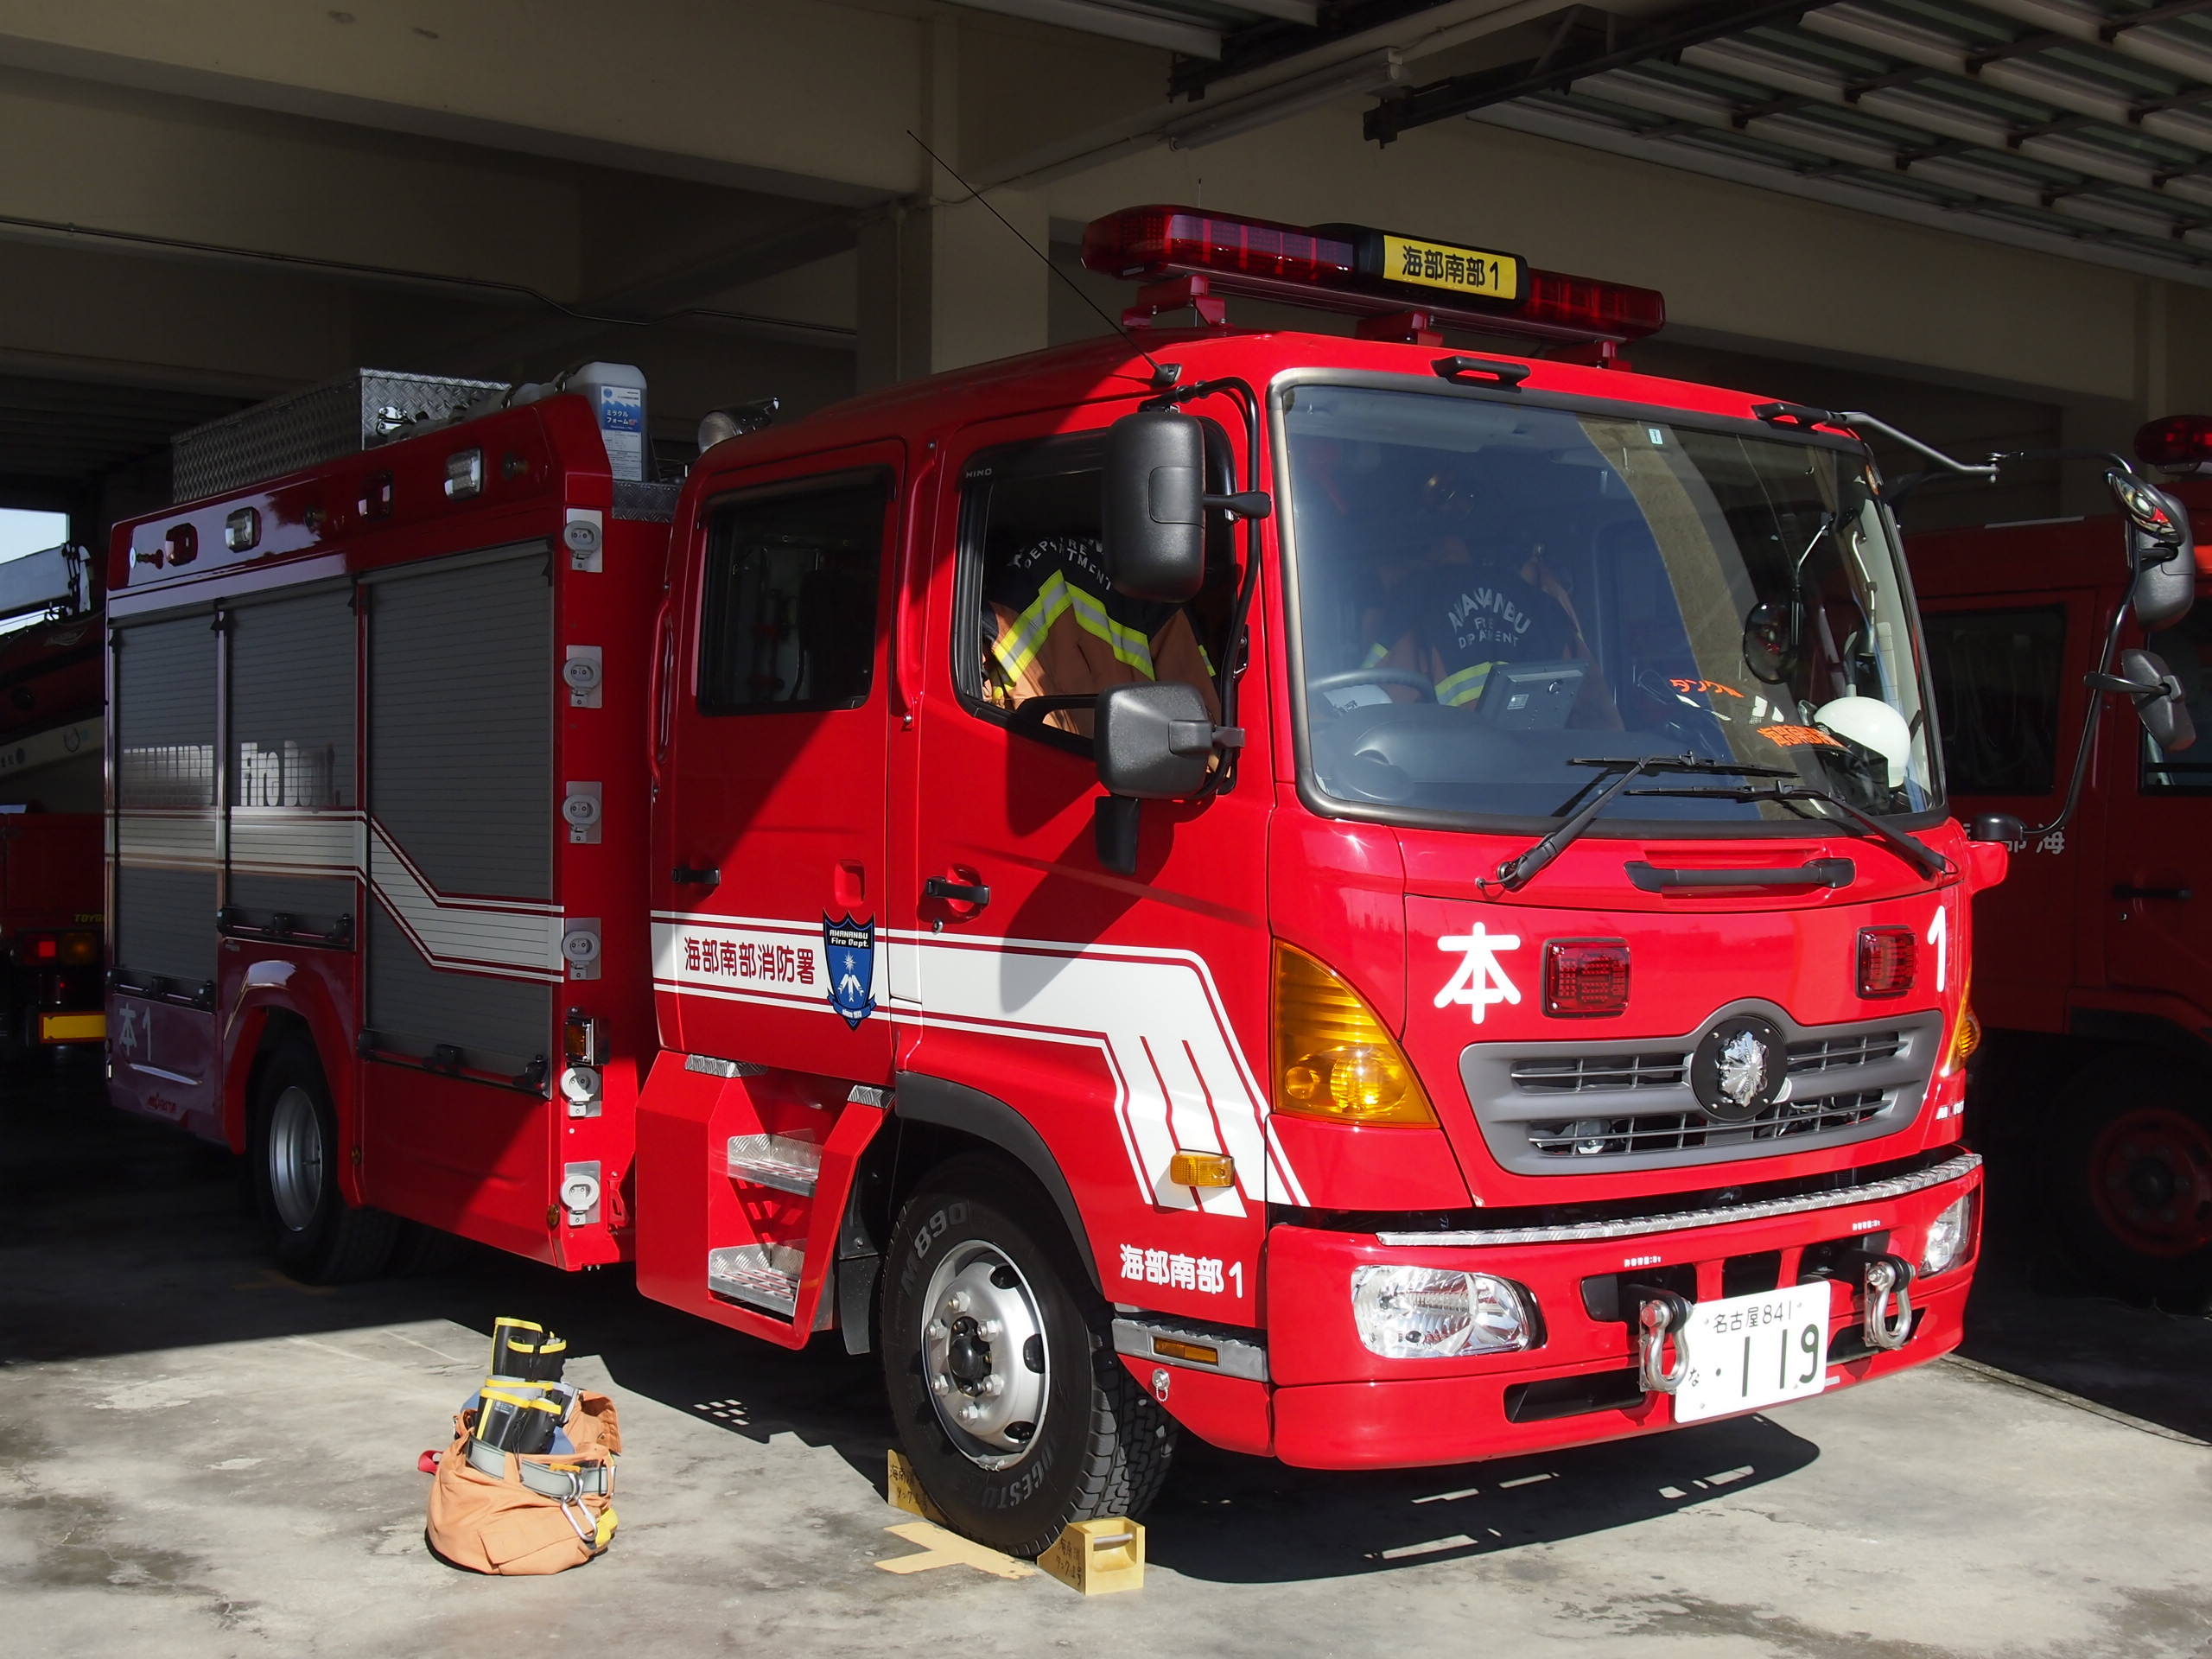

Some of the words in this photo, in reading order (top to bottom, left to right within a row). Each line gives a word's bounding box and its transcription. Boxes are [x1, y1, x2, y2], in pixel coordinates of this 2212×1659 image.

[1402, 245, 1499, 291] 海部南部1
[607, 409, 629, 417] ミラクル
[607, 416, 629, 425] フォーム
[965, 467, 993, 479] HINO
[73, 913, 105, 924] TOYO
[830, 929, 868, 940] AMANANBU
[831, 937, 847, 945] Fire
[848, 938, 869, 949] Dept.
[683, 936, 816, 985] 海部南部消防署
[1433, 921, 1522, 1025] 本
[1927, 905, 1948, 993] 1
[1119, 1243, 1243, 1299] 海部南部1
